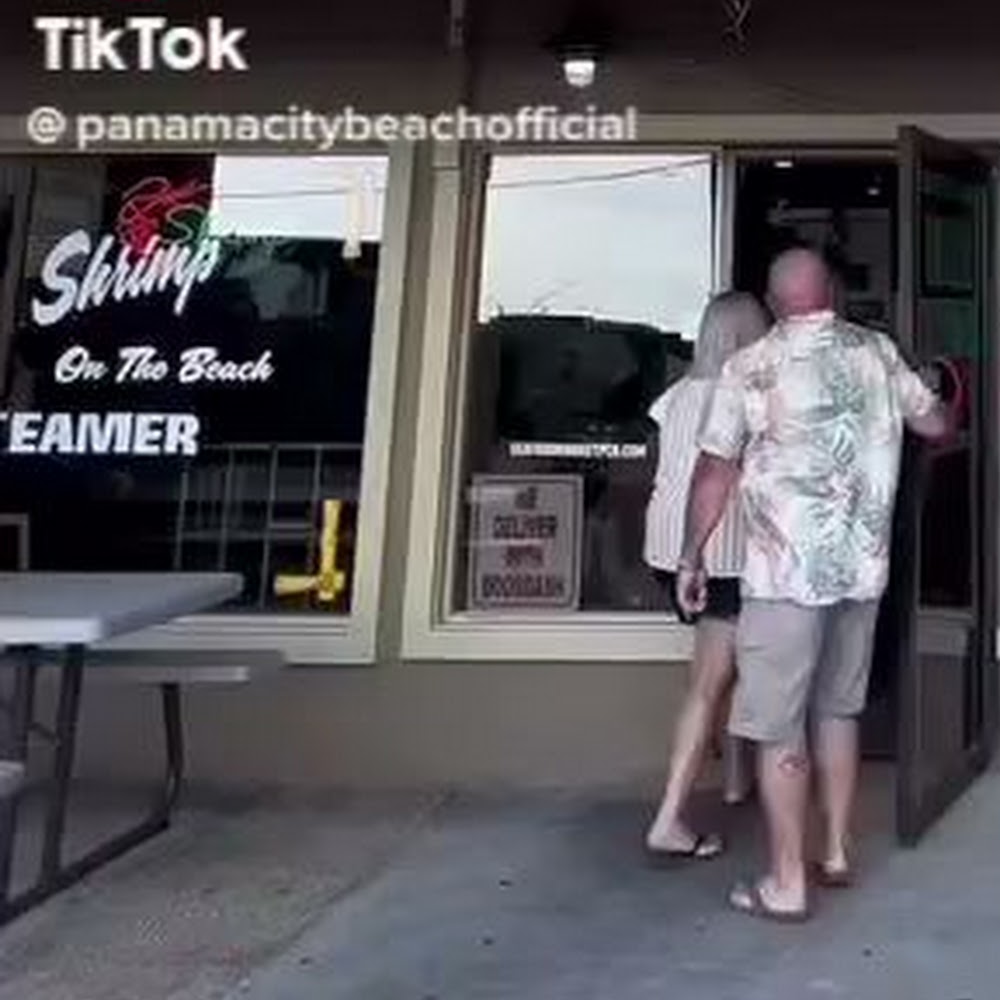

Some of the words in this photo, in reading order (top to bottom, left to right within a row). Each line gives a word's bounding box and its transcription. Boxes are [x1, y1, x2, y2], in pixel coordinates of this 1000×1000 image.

[32, 230, 220, 325] Shrimp
[54, 345, 107, 383] On
[115, 346, 168, 383] The
[178, 346, 275, 383] Beach
[0, 411, 200, 456] EAMER
